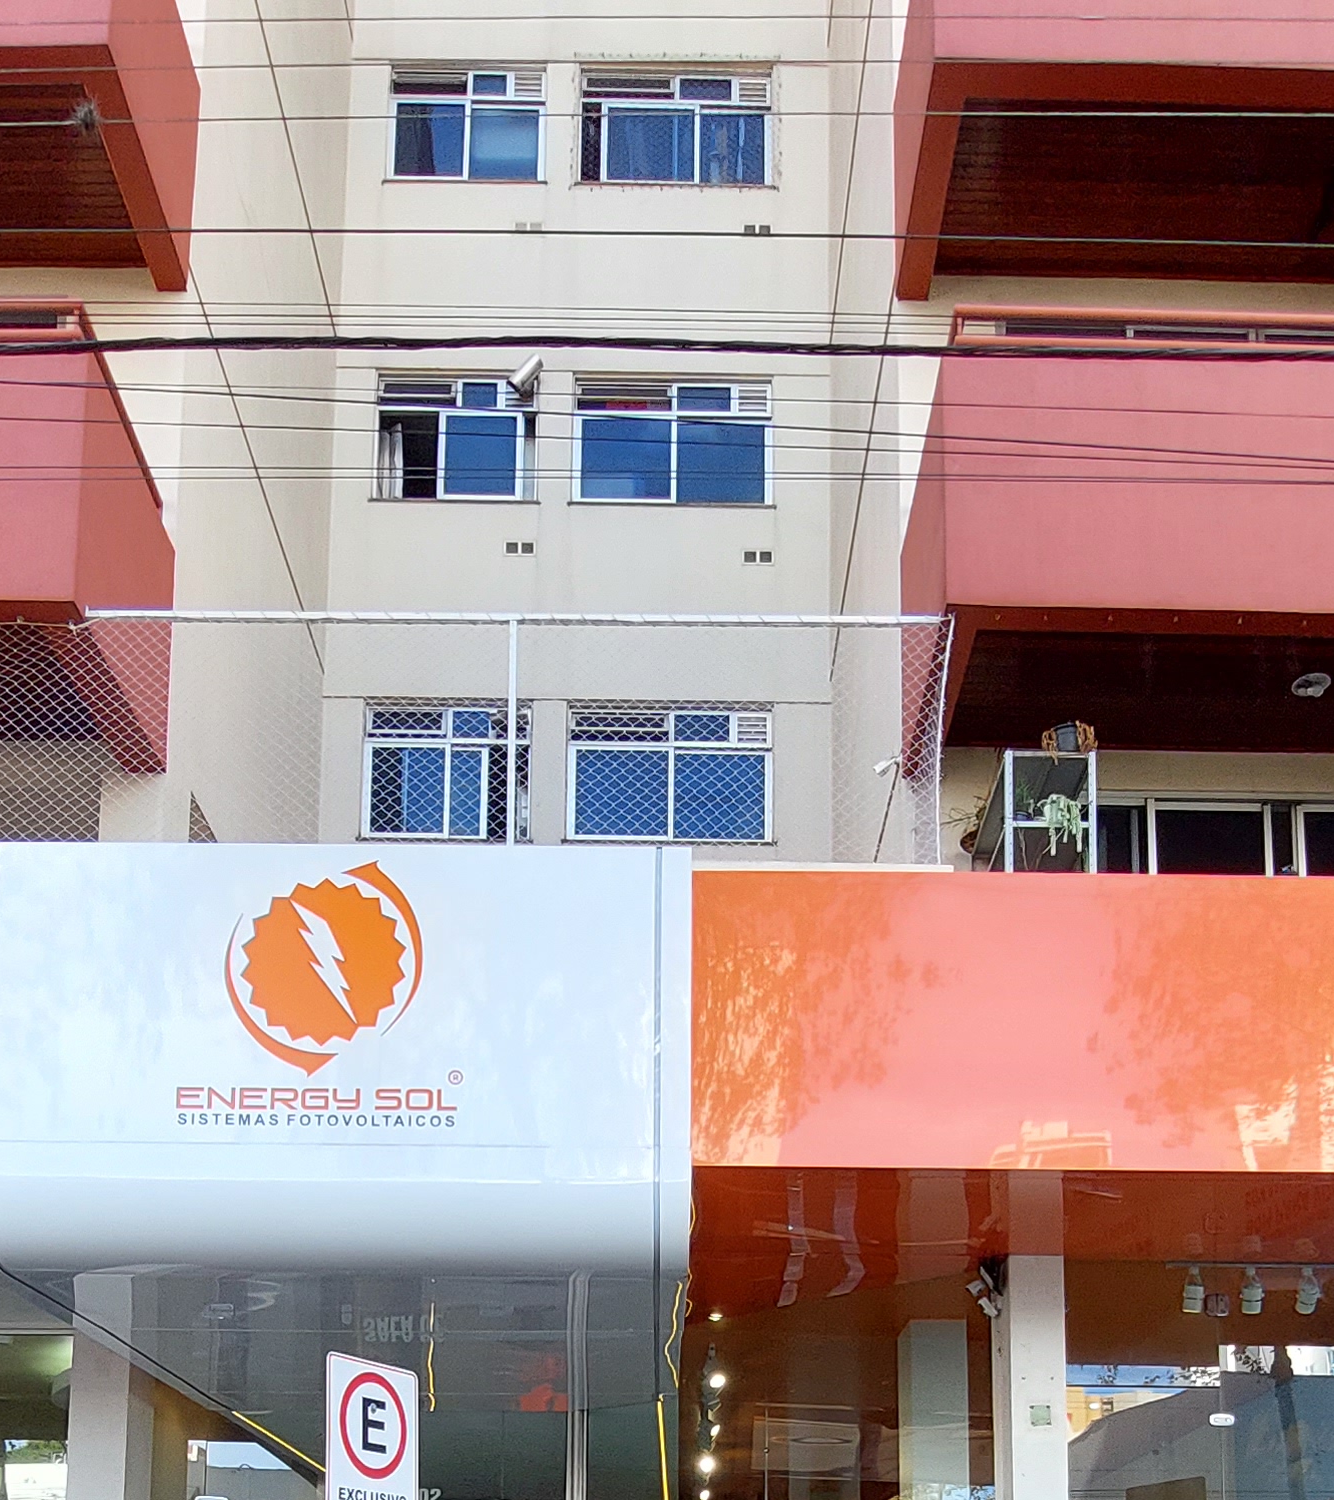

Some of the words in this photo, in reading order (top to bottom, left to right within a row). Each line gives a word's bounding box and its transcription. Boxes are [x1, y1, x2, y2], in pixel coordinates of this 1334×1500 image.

[176, 1087, 361, 1111] ENERGY
[375, 1088, 458, 1111] SOL
[177, 1113, 279, 1126] SISTEMAS
[287, 1114, 456, 1127] FOTOVOLTAICOS
[362, 1396, 387, 1454] E
